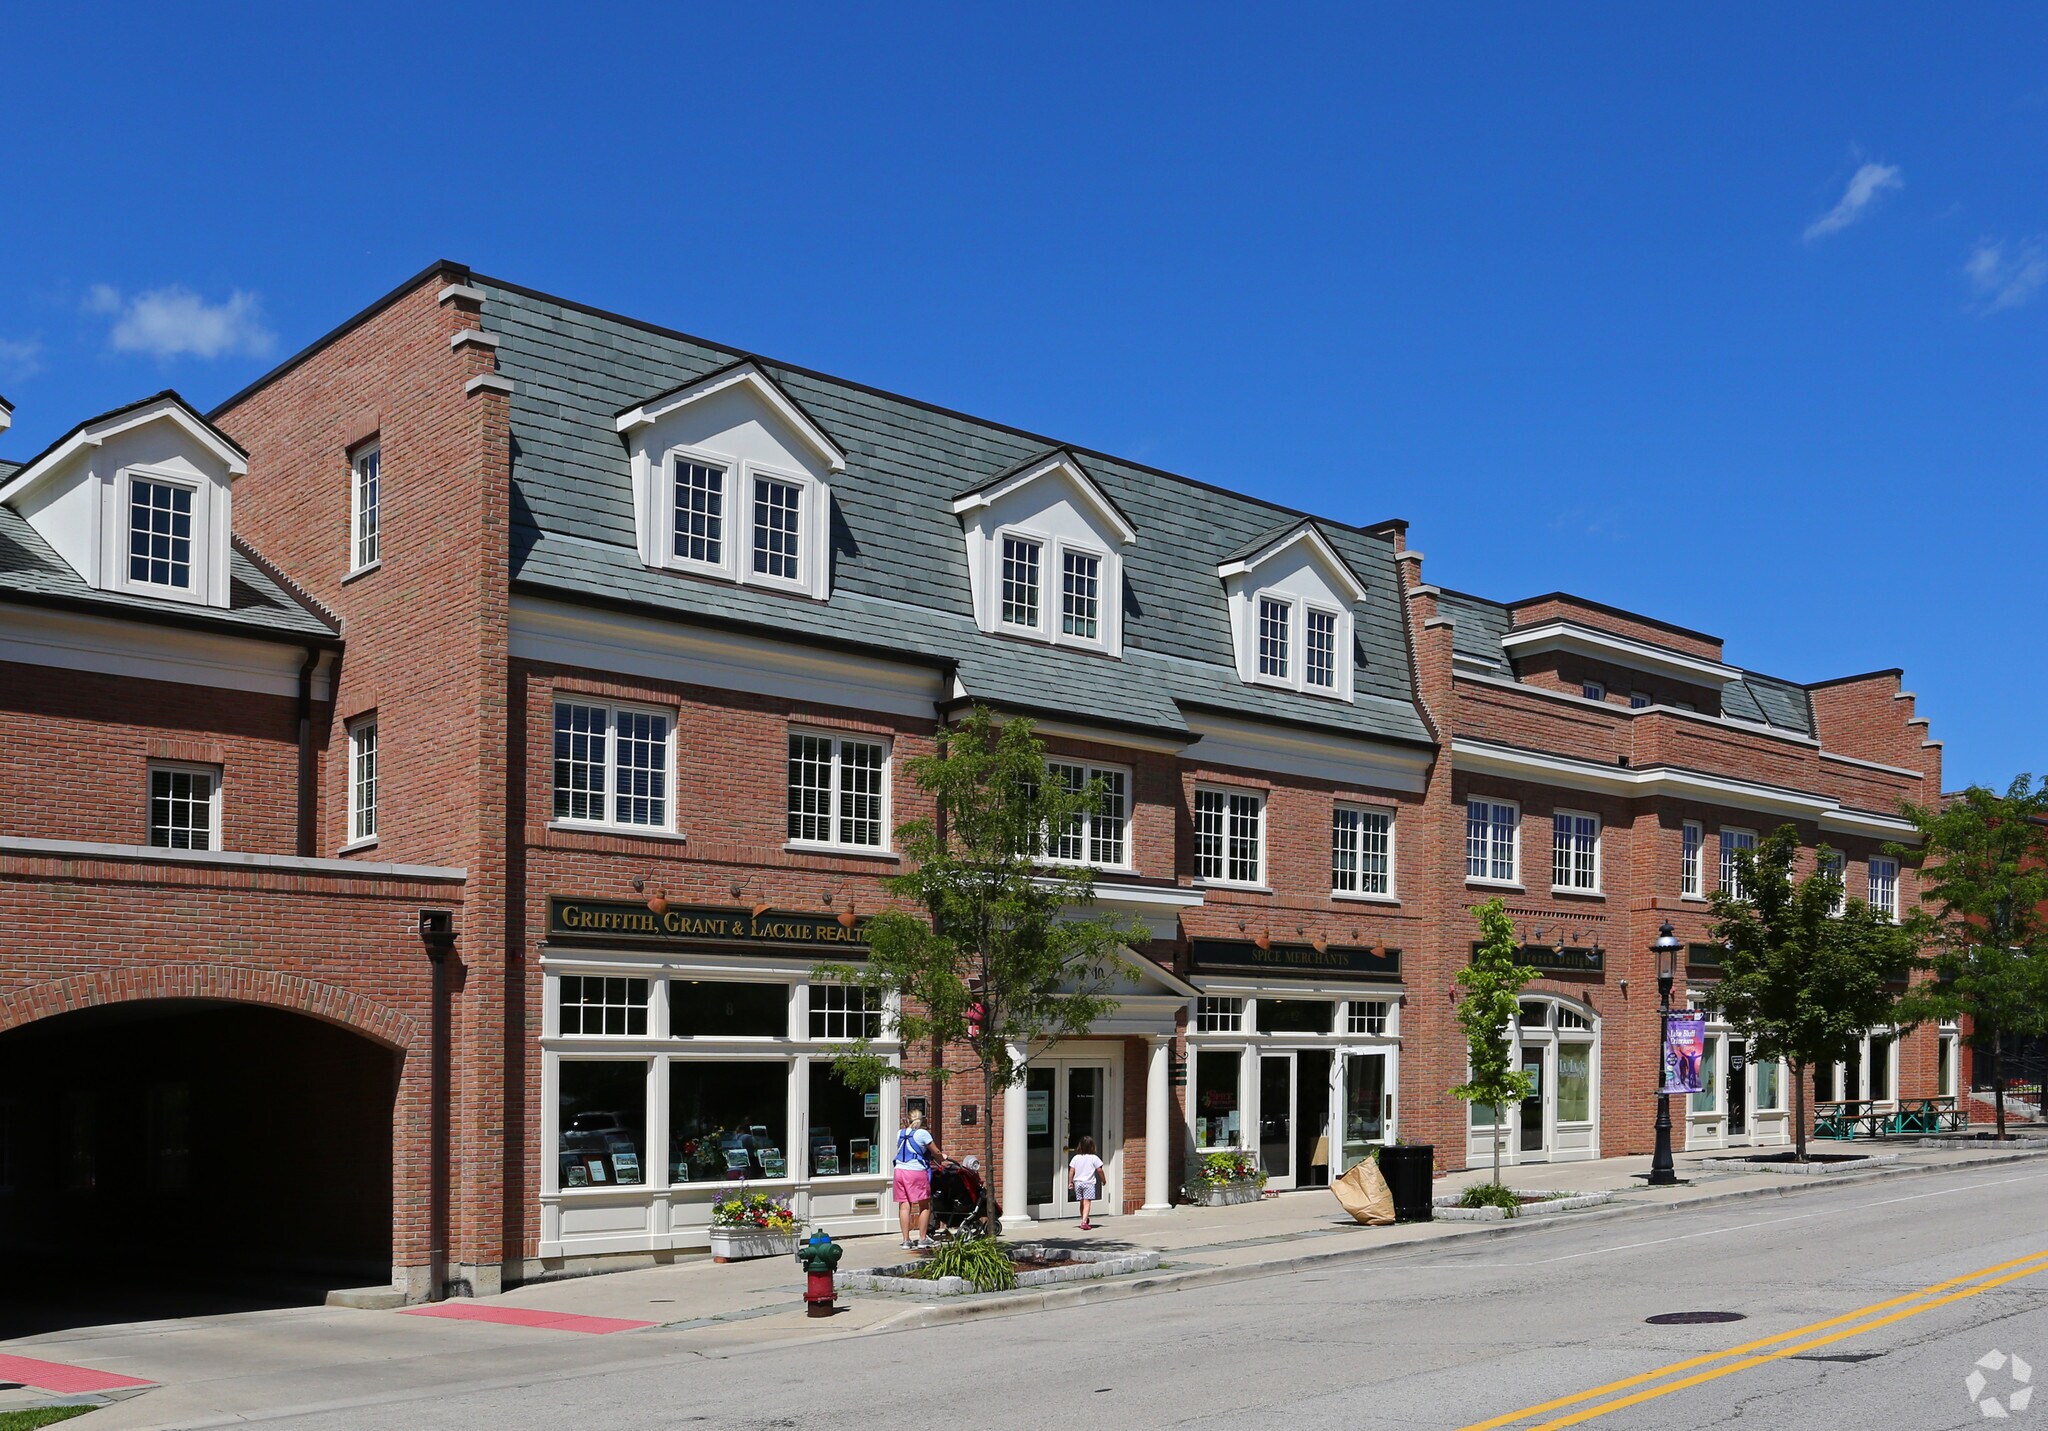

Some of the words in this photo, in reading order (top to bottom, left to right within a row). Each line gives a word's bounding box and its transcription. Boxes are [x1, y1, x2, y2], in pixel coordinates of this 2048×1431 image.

[562, 906, 660, 934] GRIFFITH,
[663, 911, 727, 935] GRANT
[732, 920, 744, 936] &
[751, 919, 812, 939] LACKIE
[816, 925, 872, 943] REALT
[1252, 949, 1280, 961] SPICE
[1286, 951, 1349, 966] MERCHANTS
[726, 1002, 733, 1015] 8
